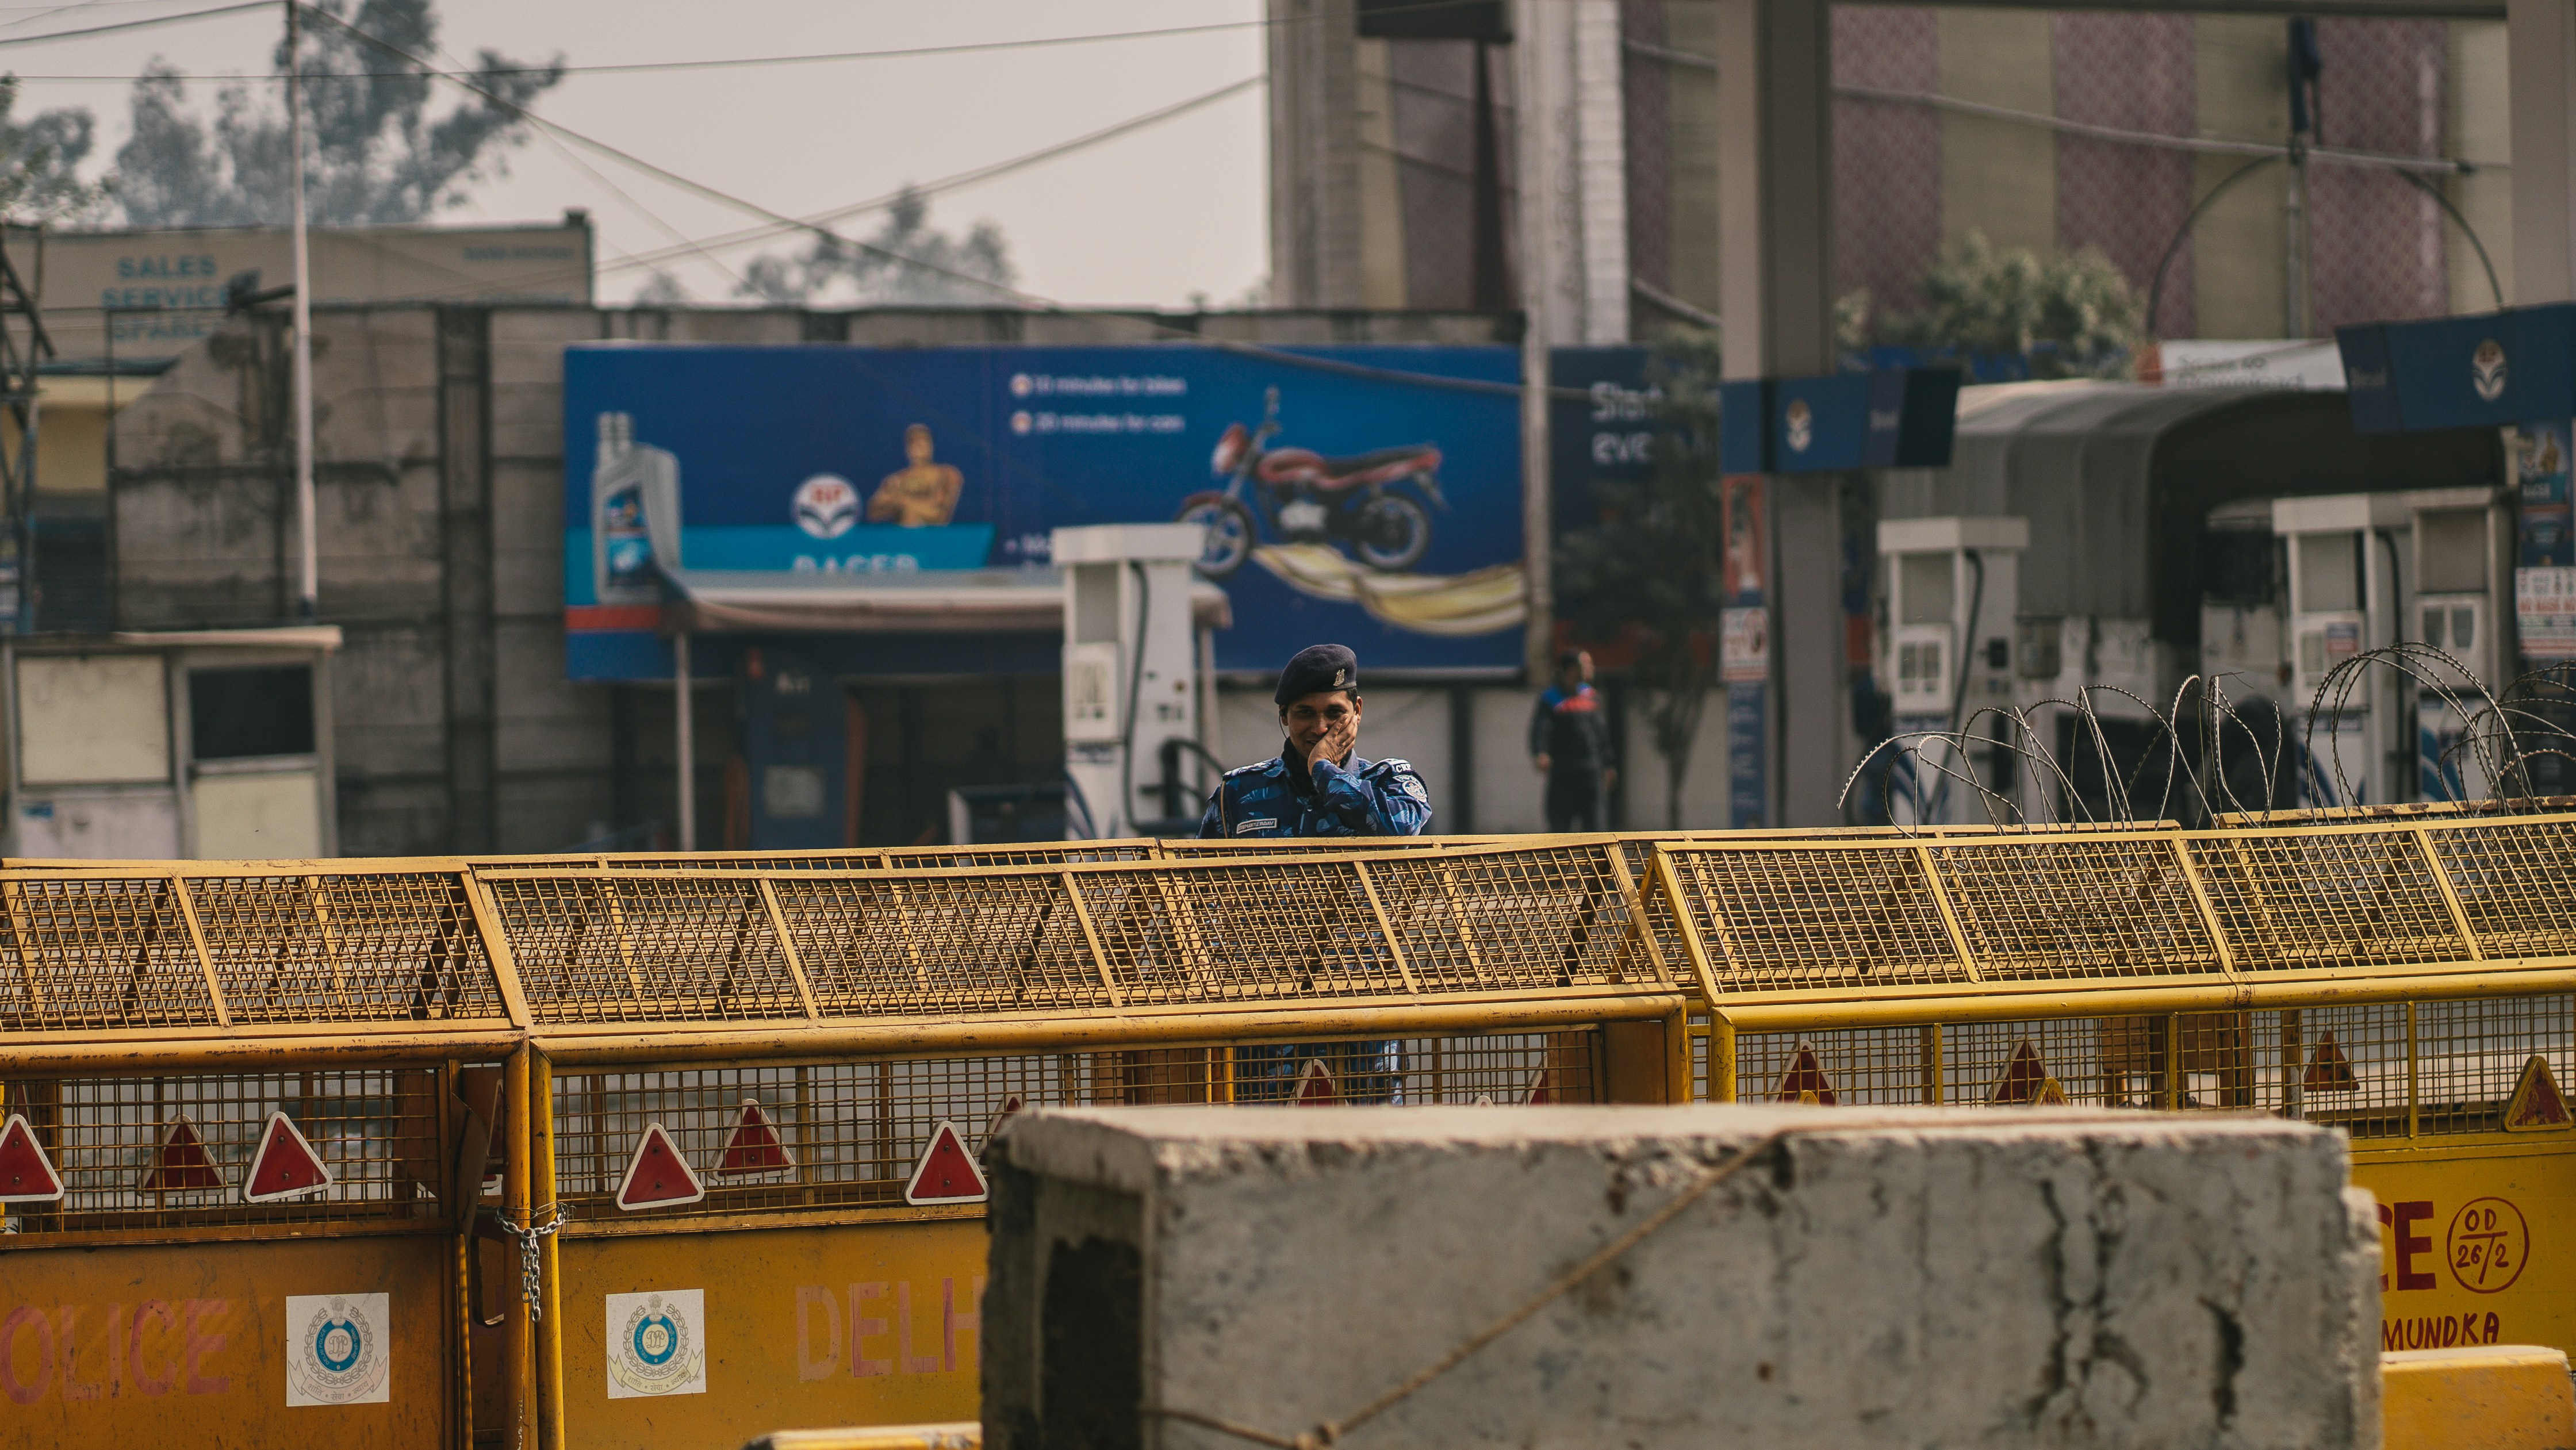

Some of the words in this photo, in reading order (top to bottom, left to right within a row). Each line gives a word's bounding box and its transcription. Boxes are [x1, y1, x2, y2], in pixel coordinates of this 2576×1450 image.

[118, 254, 216, 278] SALES
[114, 317, 223, 340] SPARE
[318, 1328, 327, 1348] POLICE
[2381, 1311, 2500, 1352] MUNDKA
